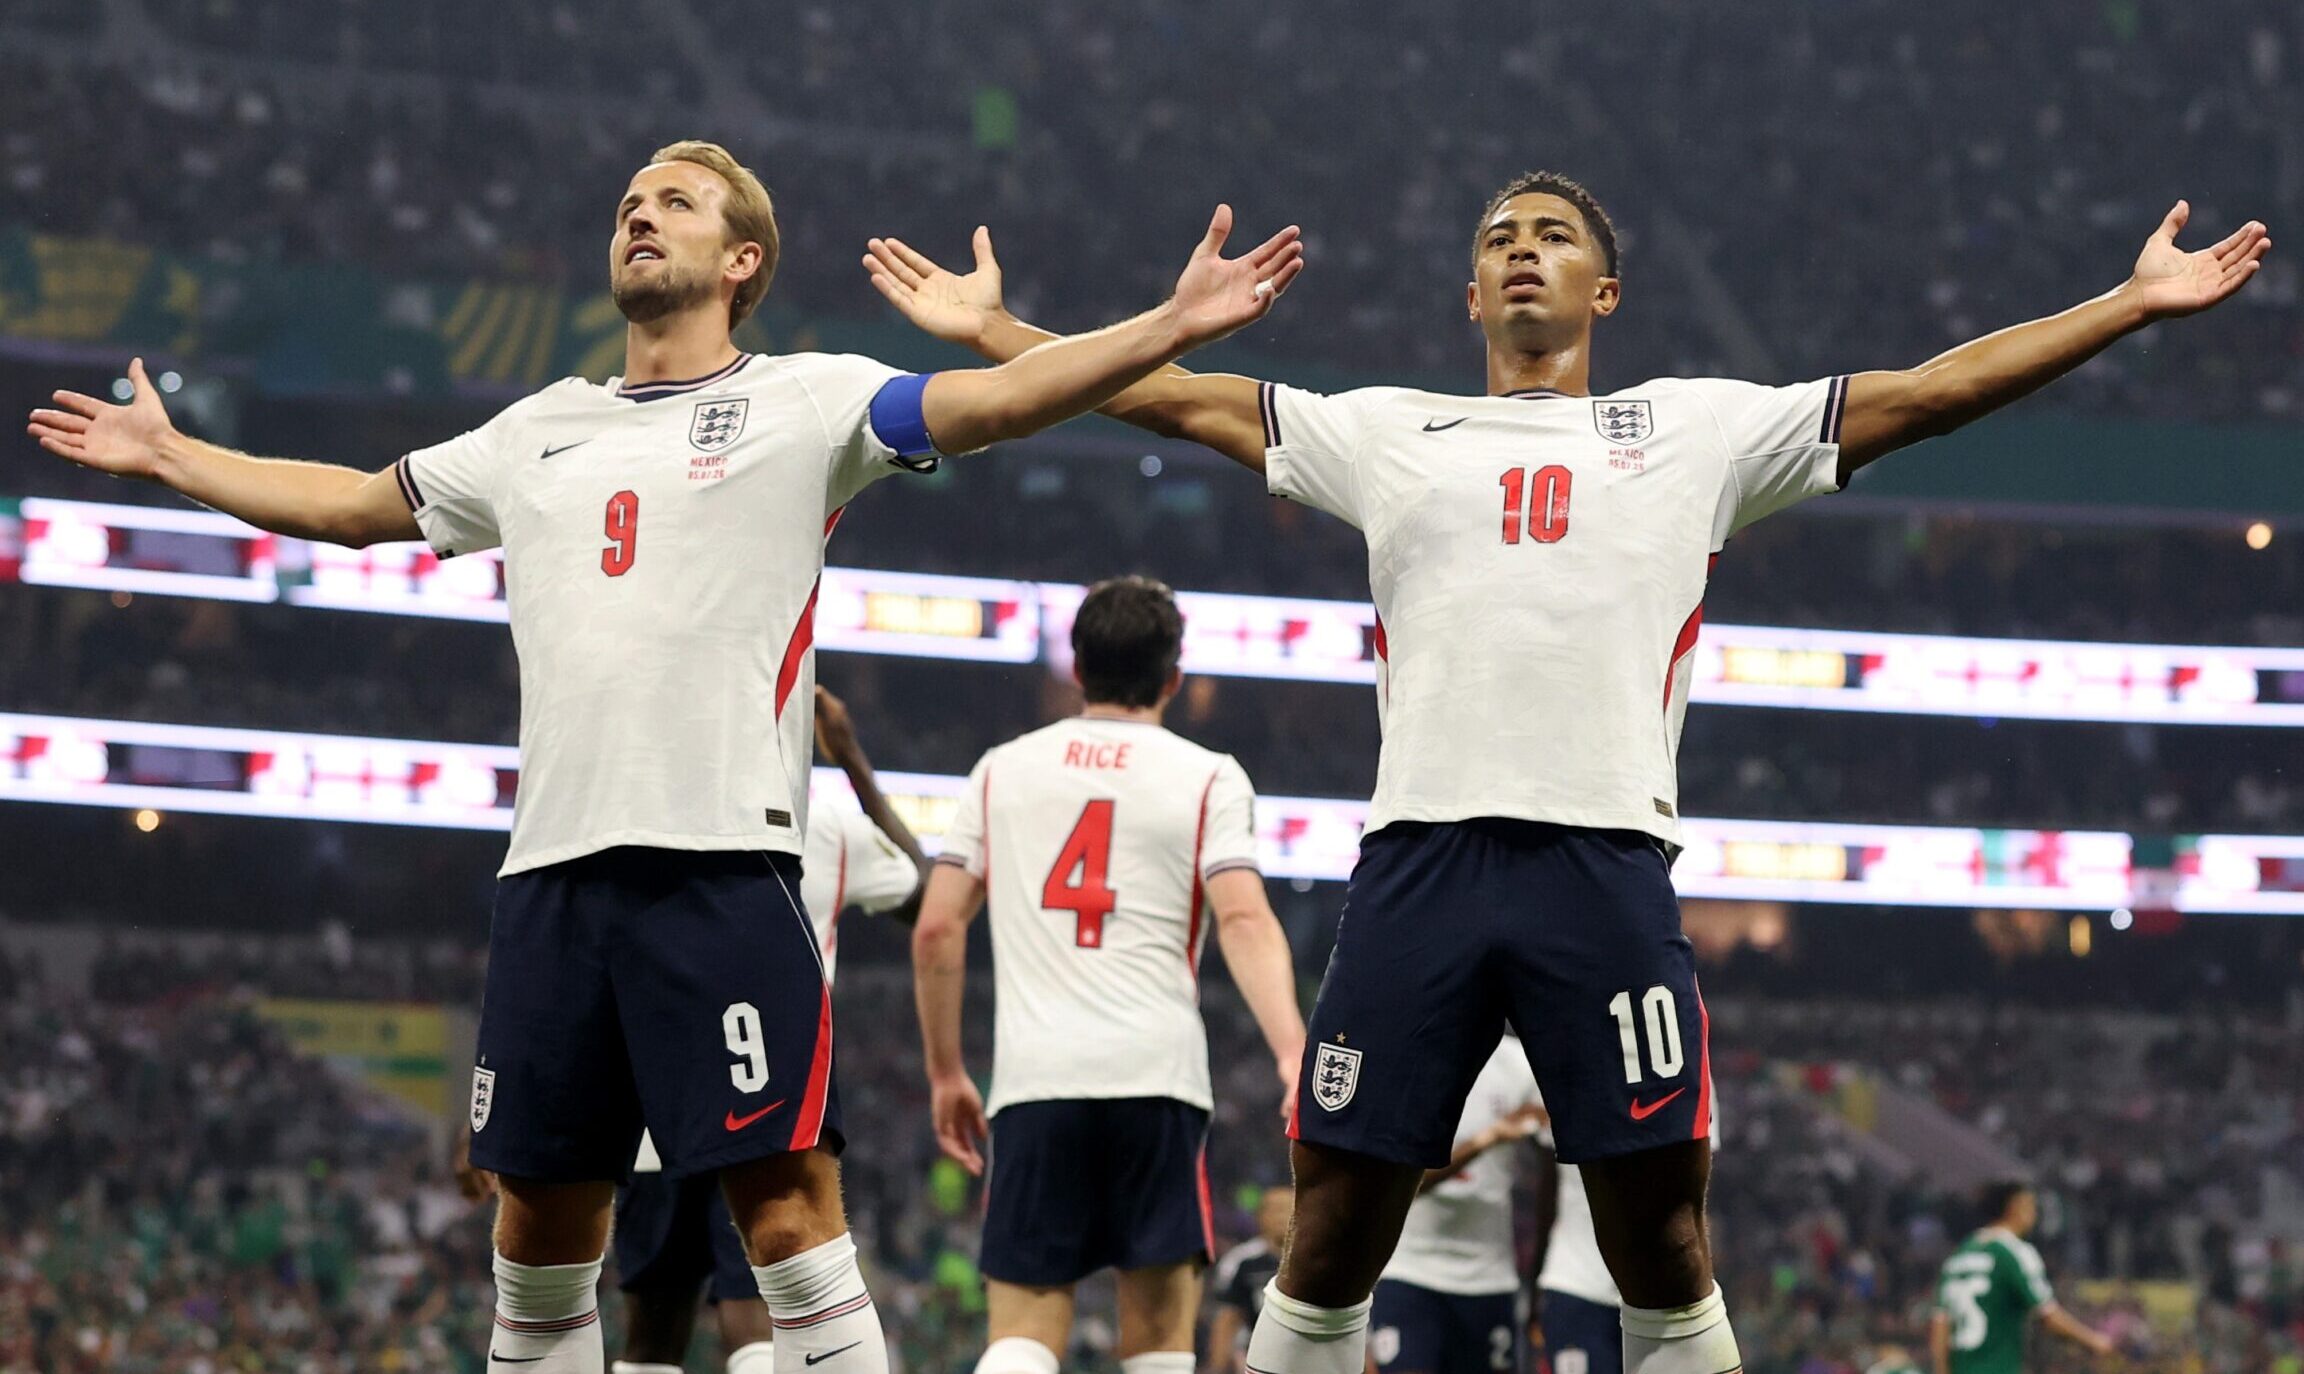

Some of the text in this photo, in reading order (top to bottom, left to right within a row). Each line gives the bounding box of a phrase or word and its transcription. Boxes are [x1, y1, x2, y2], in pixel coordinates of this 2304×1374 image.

[1609, 449, 1645, 461] MEXICO
[601, 490, 639, 577] 9
[1499, 465, 1573, 545] 10
[1064, 740, 1132, 769] RICE
[1041, 799, 1117, 949] 4
[722, 1001, 770, 1094] 9
[1609, 985, 1684, 1084] 10
